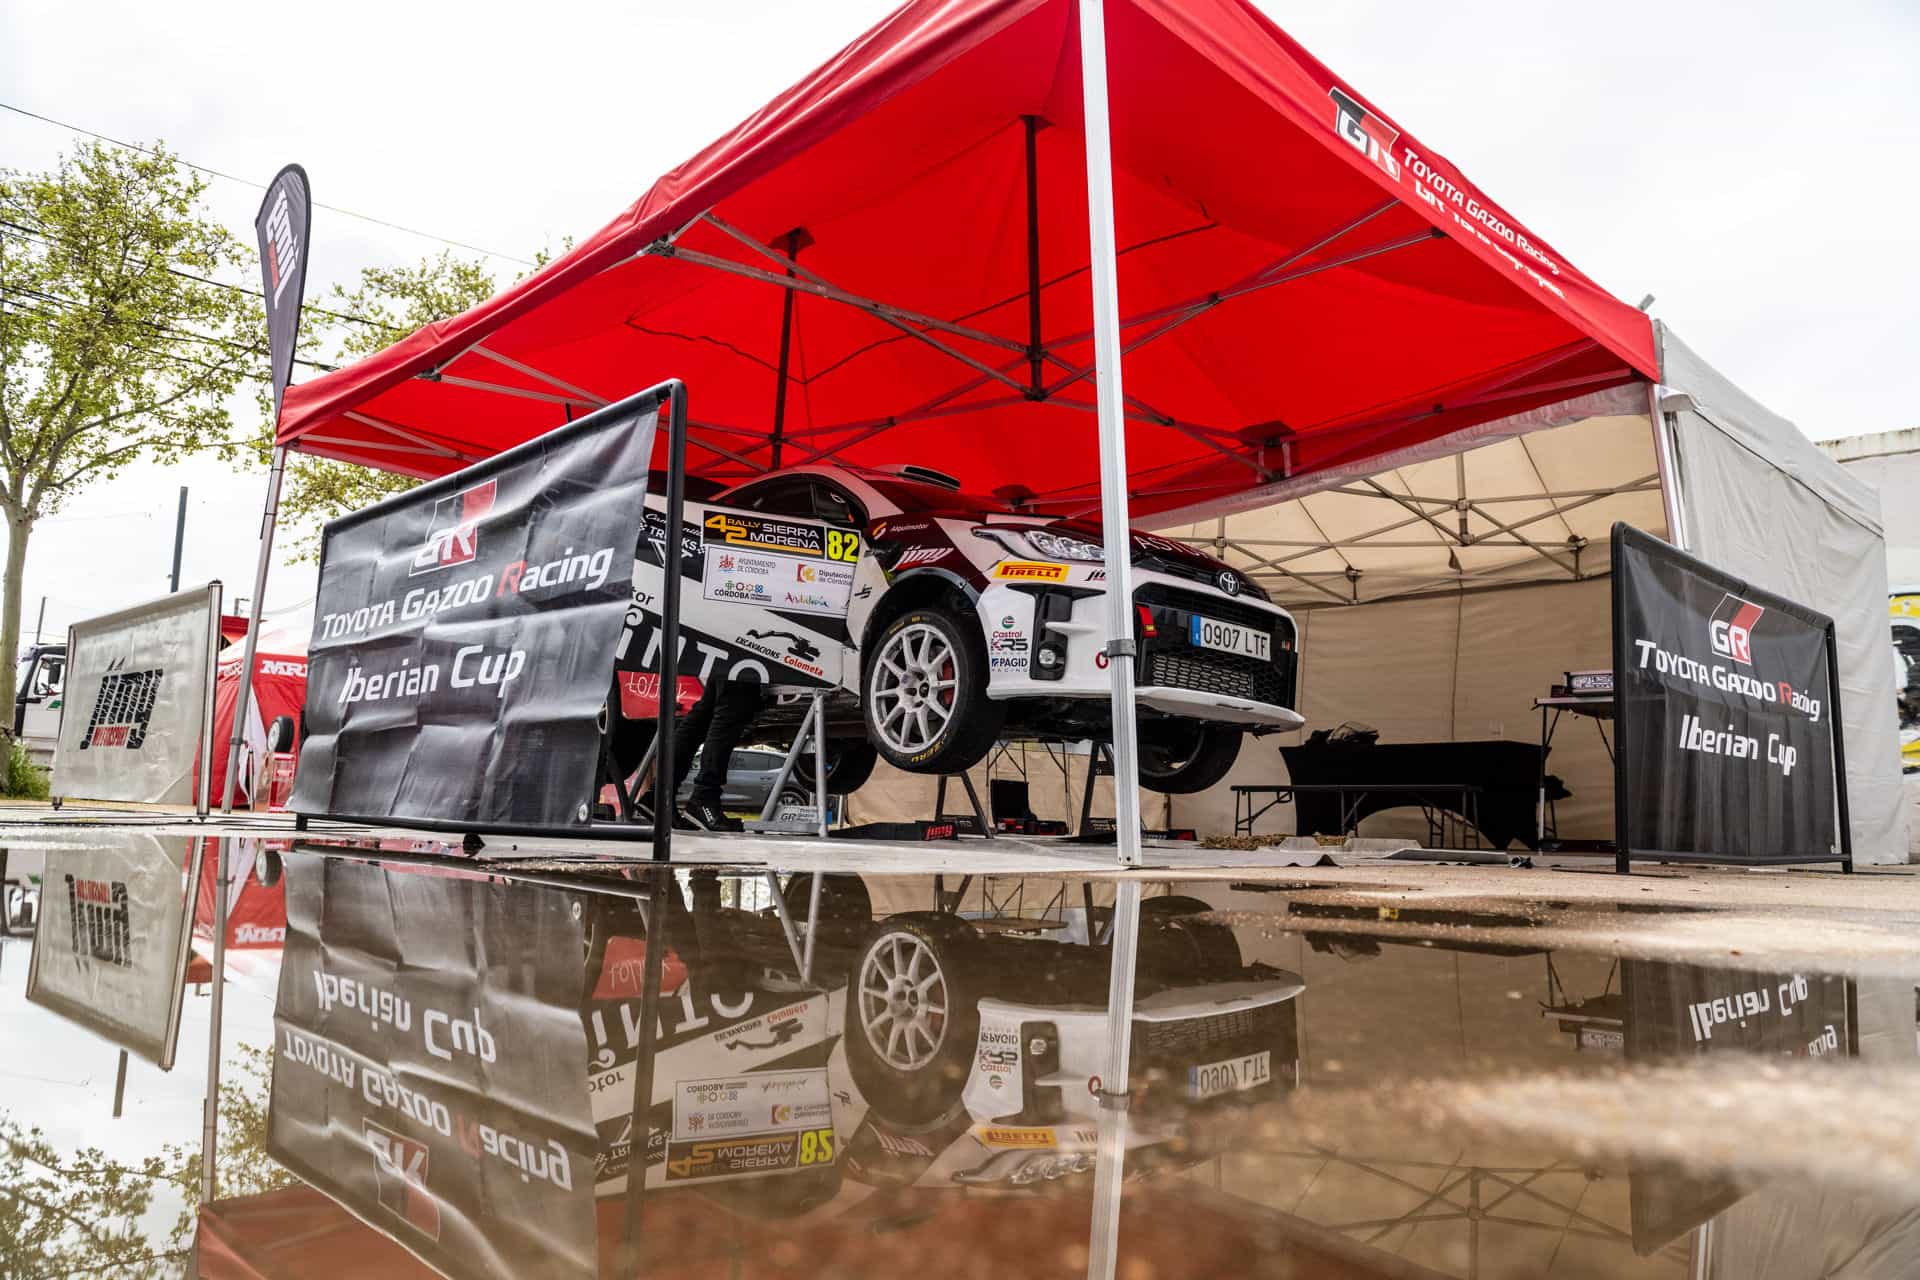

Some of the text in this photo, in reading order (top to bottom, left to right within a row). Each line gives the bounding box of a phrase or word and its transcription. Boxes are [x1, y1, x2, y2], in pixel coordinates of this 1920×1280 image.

[1404, 148, 1561, 275] TOYOTA GAZOO Racing
[727, 518, 761, 530] RALLY
[762, 523, 820, 539] SIERRA
[749, 532, 820, 549] MORENA
[827, 530, 859, 563] 82
[1001, 565, 1062, 579] PIRELLI
[322, 547, 615, 641] TOYOTA GAZOO Racing
[735, 635, 780, 659] EXCAVACIONS
[992, 630, 1023, 639] Castrol
[1203, 623, 1268, 657] 0907 LTF
[1711, 618, 1750, 660] GR
[338, 644, 526, 704] Iberian Cup
[1000, 658, 1028, 667] PAGID
[1635, 639, 1711, 688] TOYOTA
[1712, 666, 1776, 701] GAZOO
[1679, 714, 1797, 776] Iberian Cup
